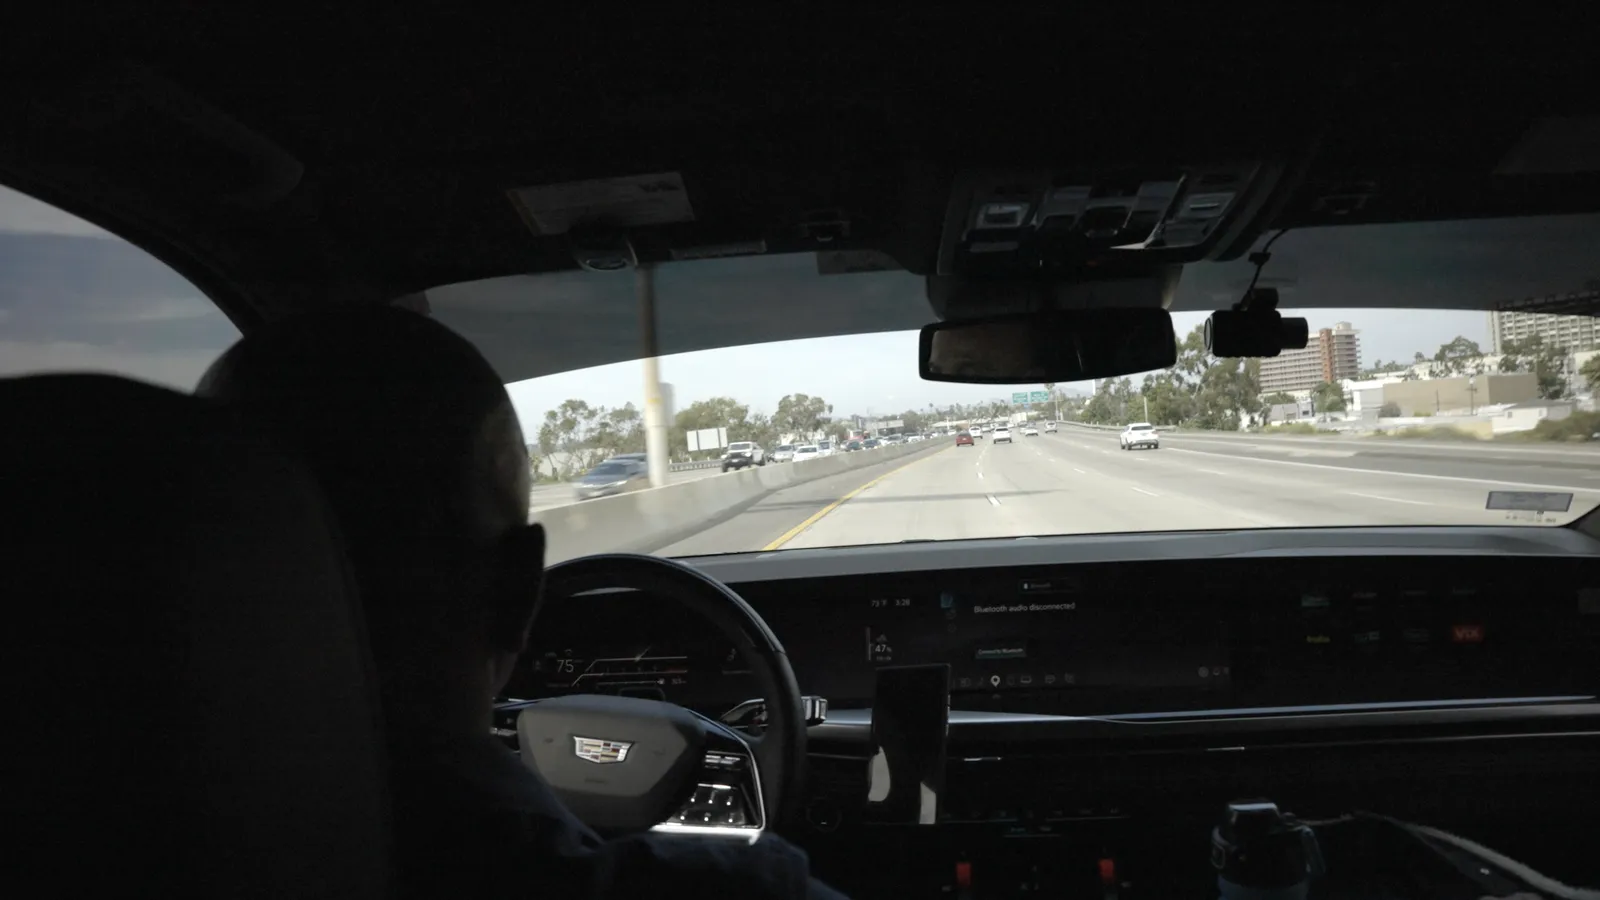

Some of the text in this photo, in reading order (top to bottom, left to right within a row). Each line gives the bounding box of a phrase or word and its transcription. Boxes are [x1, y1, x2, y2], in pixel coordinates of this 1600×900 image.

[974, 601, 1076, 614] Bluetooth audio disconnected
[556, 659, 574, 673] 75
